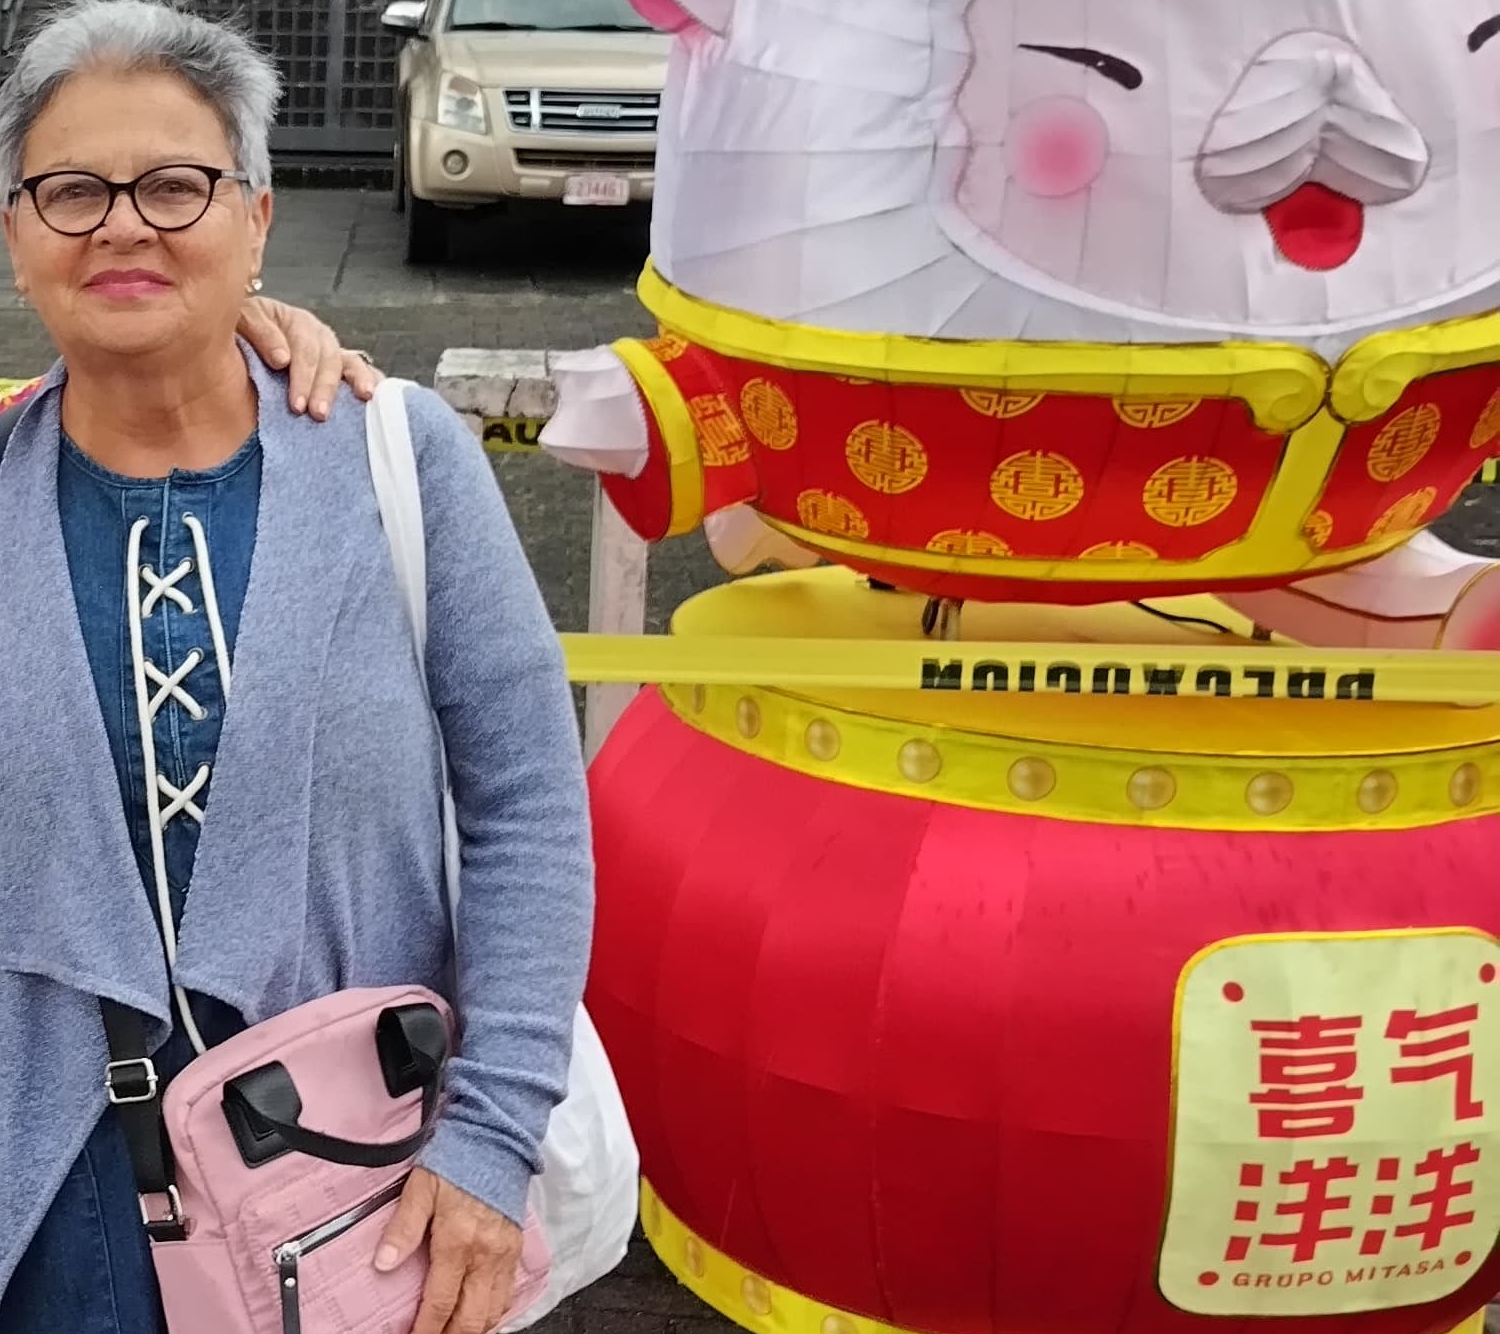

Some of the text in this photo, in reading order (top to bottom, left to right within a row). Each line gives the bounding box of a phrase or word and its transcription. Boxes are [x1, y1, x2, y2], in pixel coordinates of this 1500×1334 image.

[1249, 1004, 1484, 1139] 喜气
[1224, 1142, 1481, 1263] 洋洋
[1232, 1259, 1445, 1289] GRUPO MITASA
